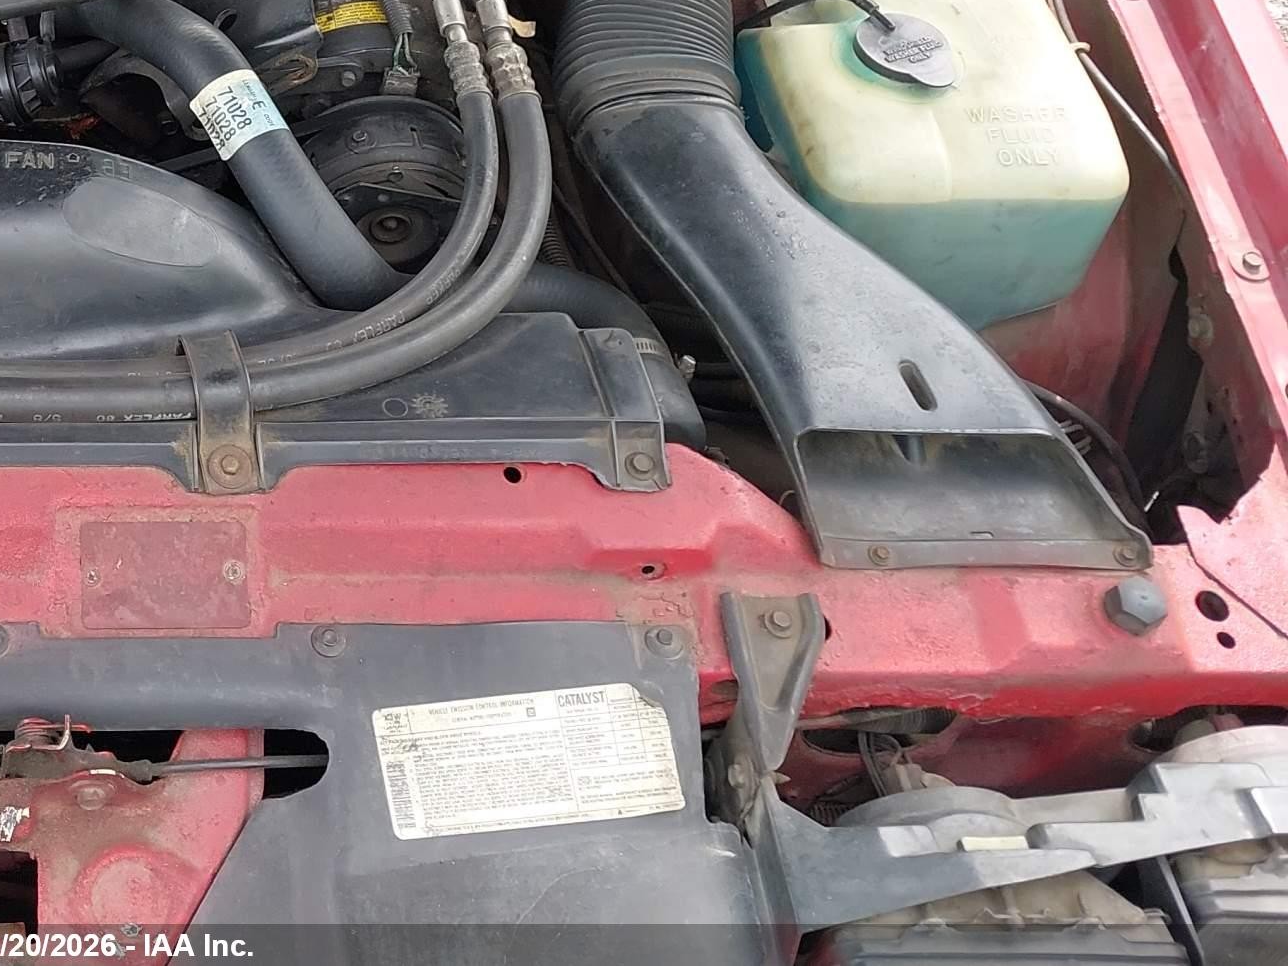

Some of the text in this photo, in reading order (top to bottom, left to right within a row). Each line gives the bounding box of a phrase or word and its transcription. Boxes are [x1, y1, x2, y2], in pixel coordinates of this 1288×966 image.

[908, 52, 930, 64] ONLY
[217, 86, 253, 130] 71028
[964, 106, 1065, 124] WASHER
[205, 96, 237, 142] 71028
[985, 128, 1054, 145] FLUID
[4, 151, 55, 170] FAN
[997, 147, 1059, 167] ONLY
[426, 266, 463, 305] PARKER
[557, 690, 606, 708] CATALYST
